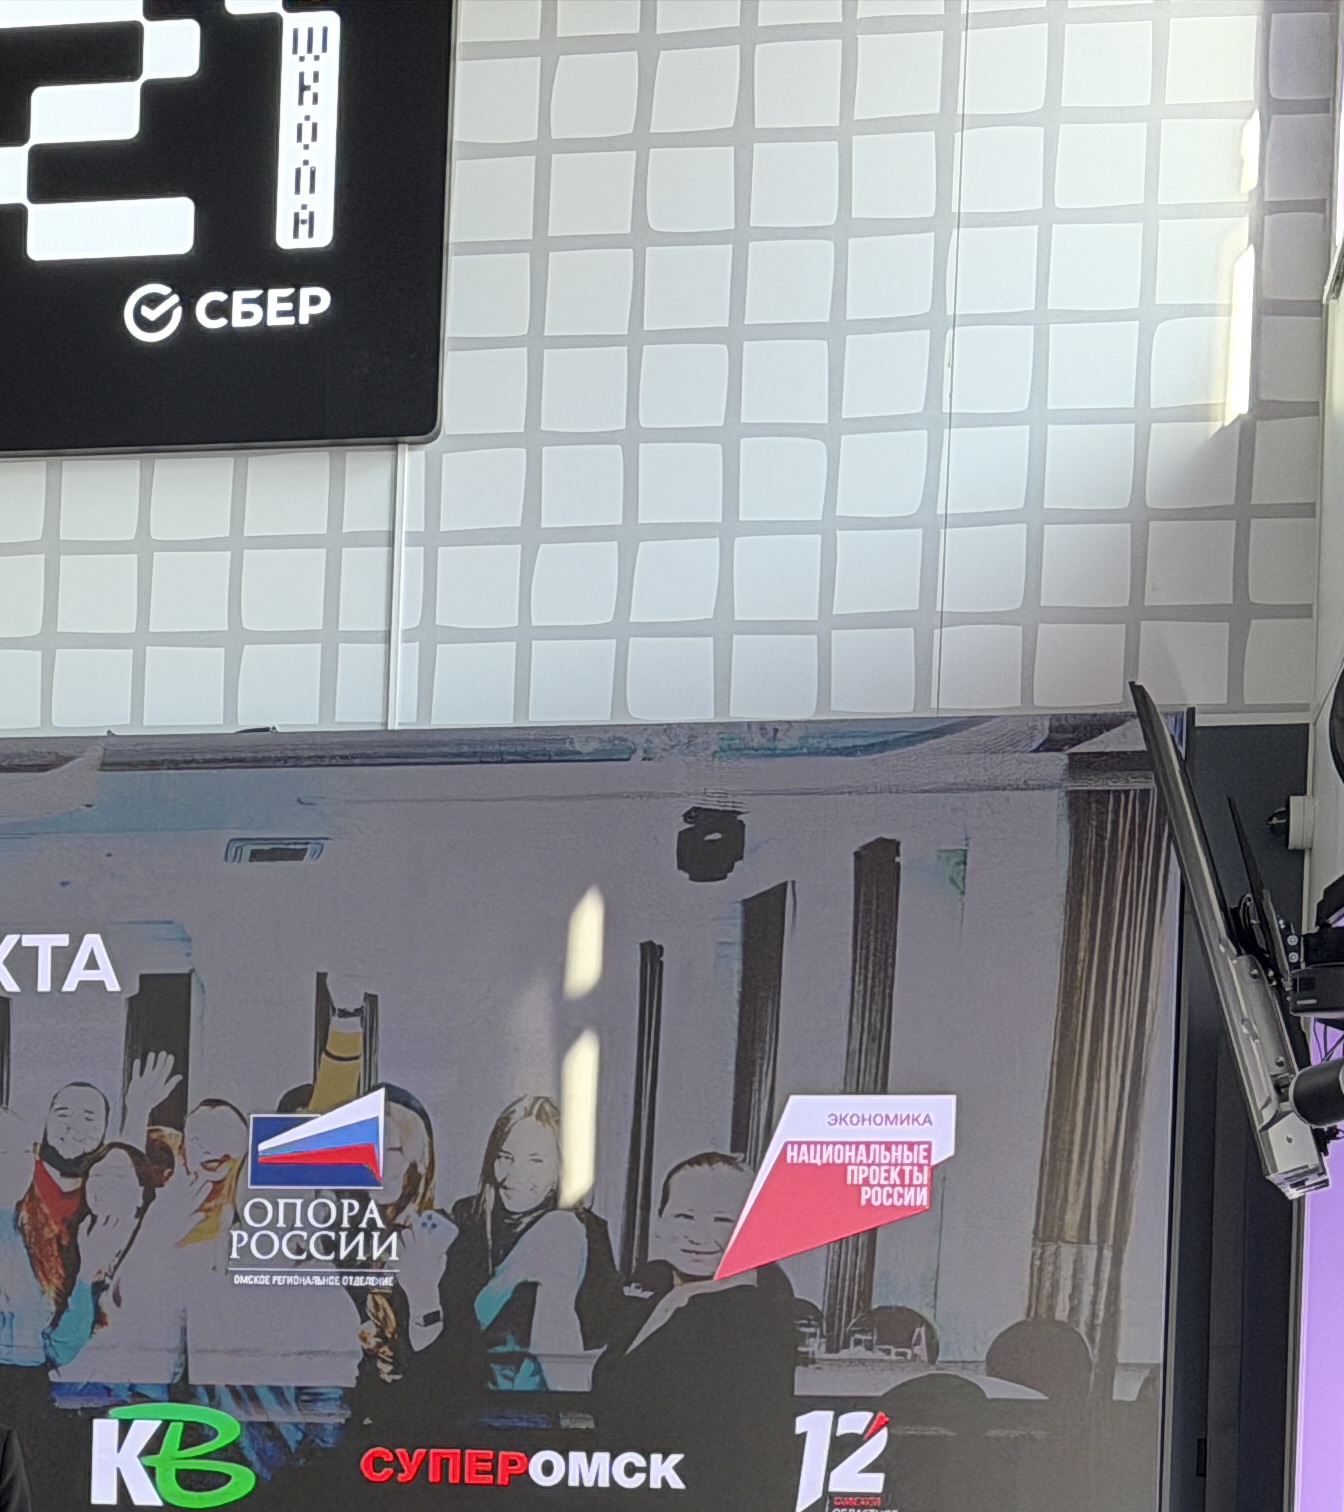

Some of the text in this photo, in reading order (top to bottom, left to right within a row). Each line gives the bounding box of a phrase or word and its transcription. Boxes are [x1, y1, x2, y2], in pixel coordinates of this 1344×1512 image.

[195, 286, 331, 330] СБЕР
[826, 1112, 934, 1127] ЭКОНОМИКА
[786, 1144, 930, 1166] НАЦИОНАЛЬНЫЕ
[846, 1165, 929, 1185] ПРОЕКТЫ
[860, 1186, 929, 1207] РОССИИ
[243, 1197, 387, 1229] ОПОРА
[229, 1230, 400, 1261] РОССИИ
[359, 1446, 686, 1490] СУПЕРОМСК
